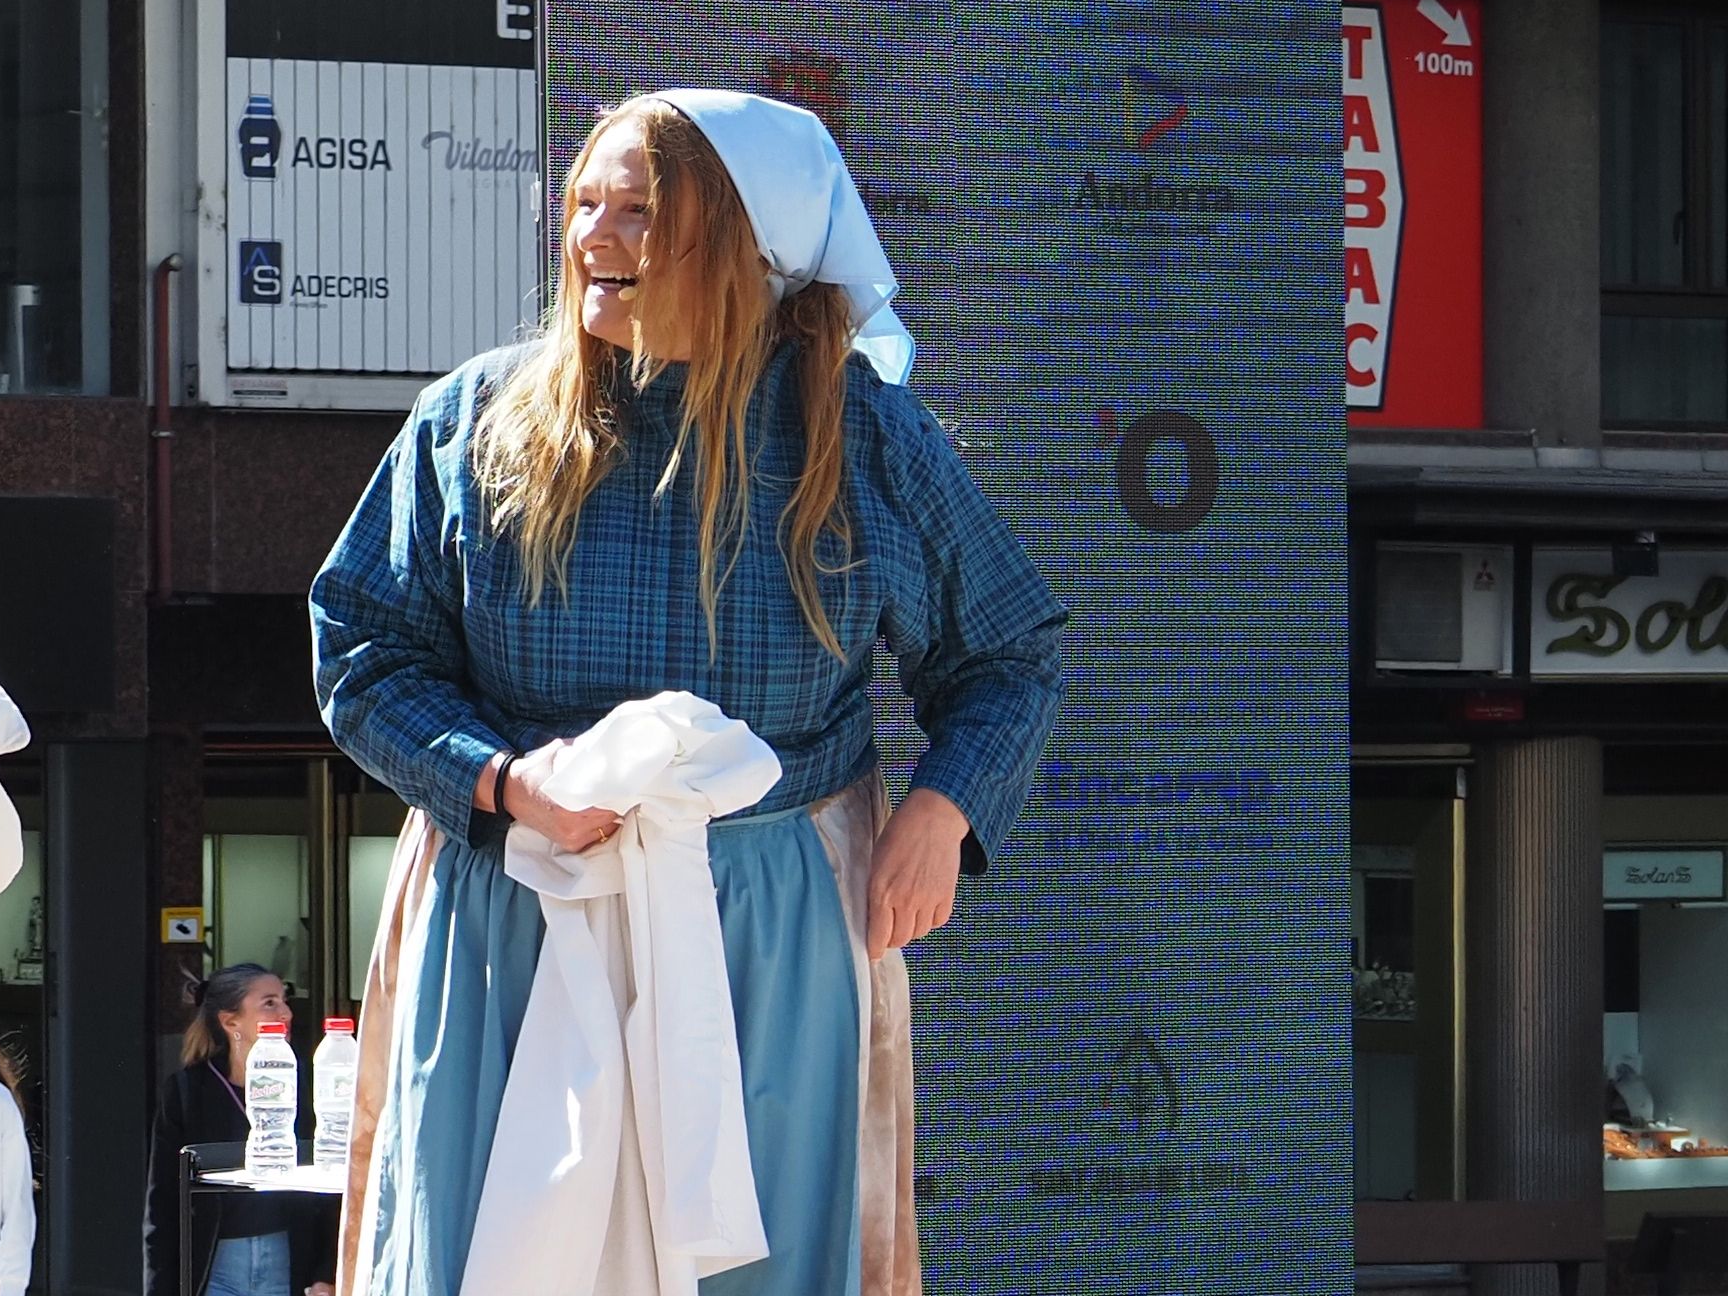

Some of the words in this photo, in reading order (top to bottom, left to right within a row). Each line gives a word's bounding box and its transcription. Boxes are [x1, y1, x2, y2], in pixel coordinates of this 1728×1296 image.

[1414, 50, 1474, 77] 100m
[291, 136, 393, 172] AGISA
[291, 274, 390, 300] ADECRIS
